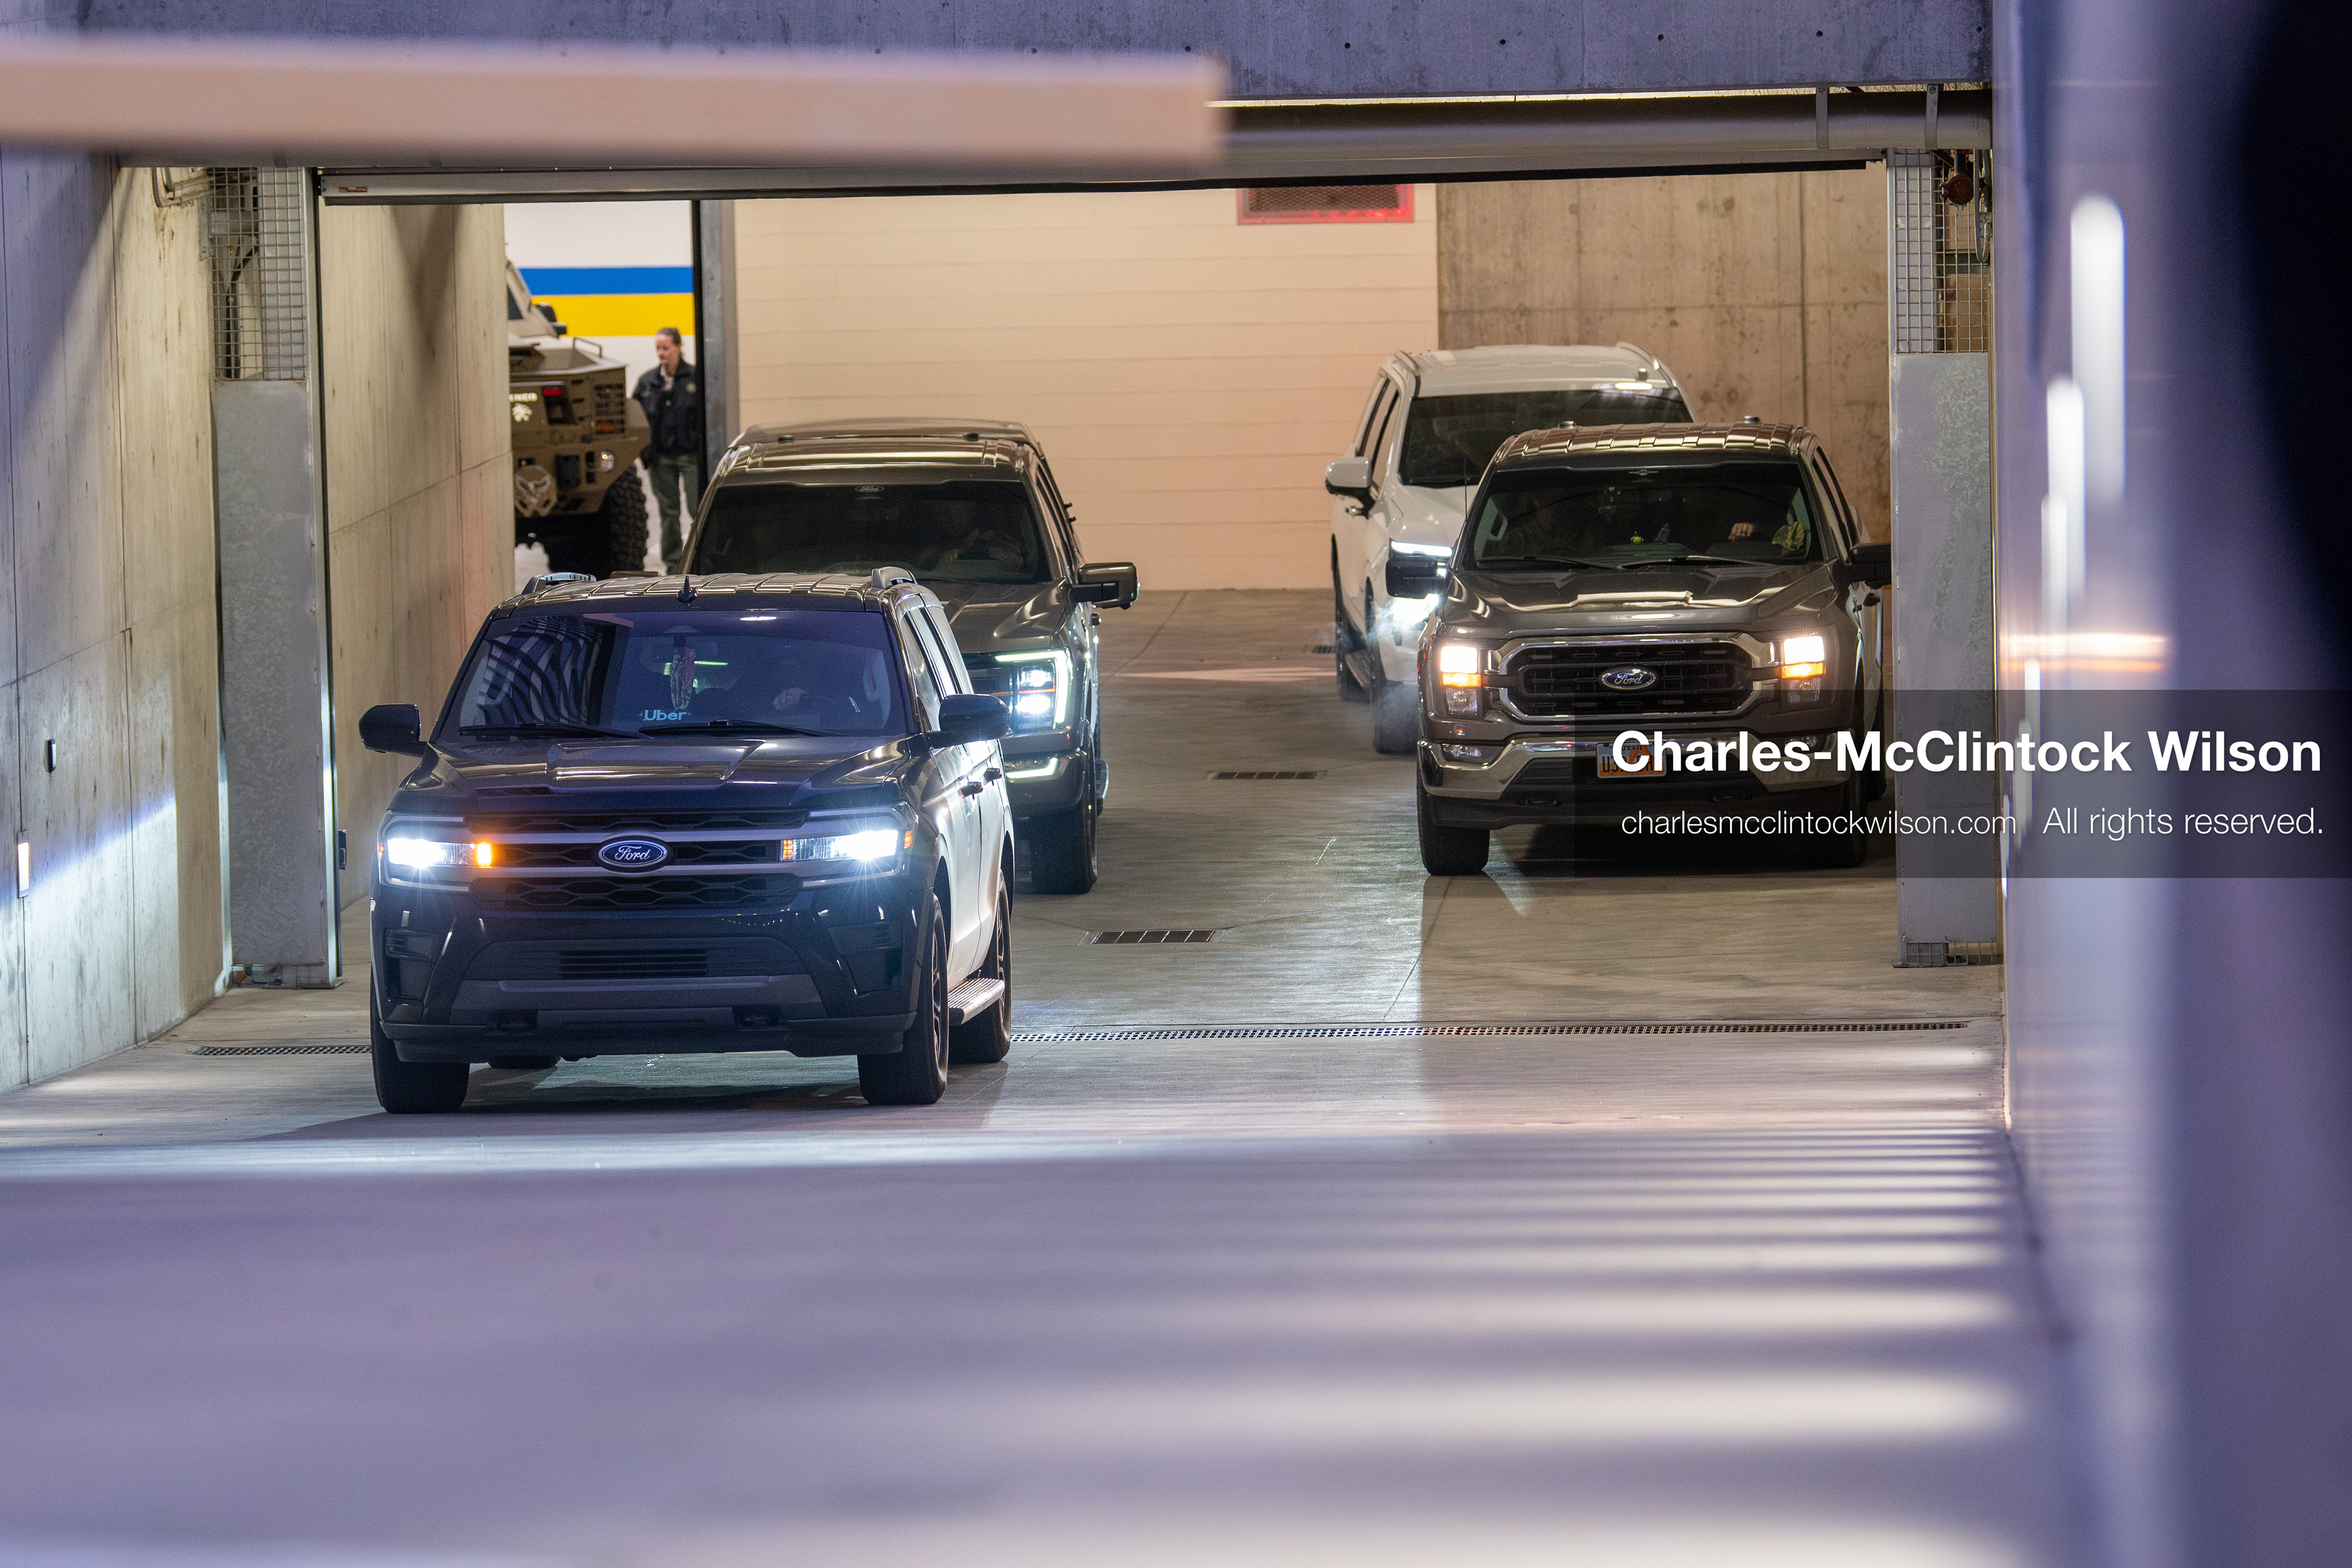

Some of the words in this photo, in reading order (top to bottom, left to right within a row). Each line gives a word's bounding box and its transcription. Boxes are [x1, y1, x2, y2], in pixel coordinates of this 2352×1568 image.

[1614, 673, 1643, 685] Ford
[644, 709, 687, 721] Uber
[614, 845, 650, 860] Ford
